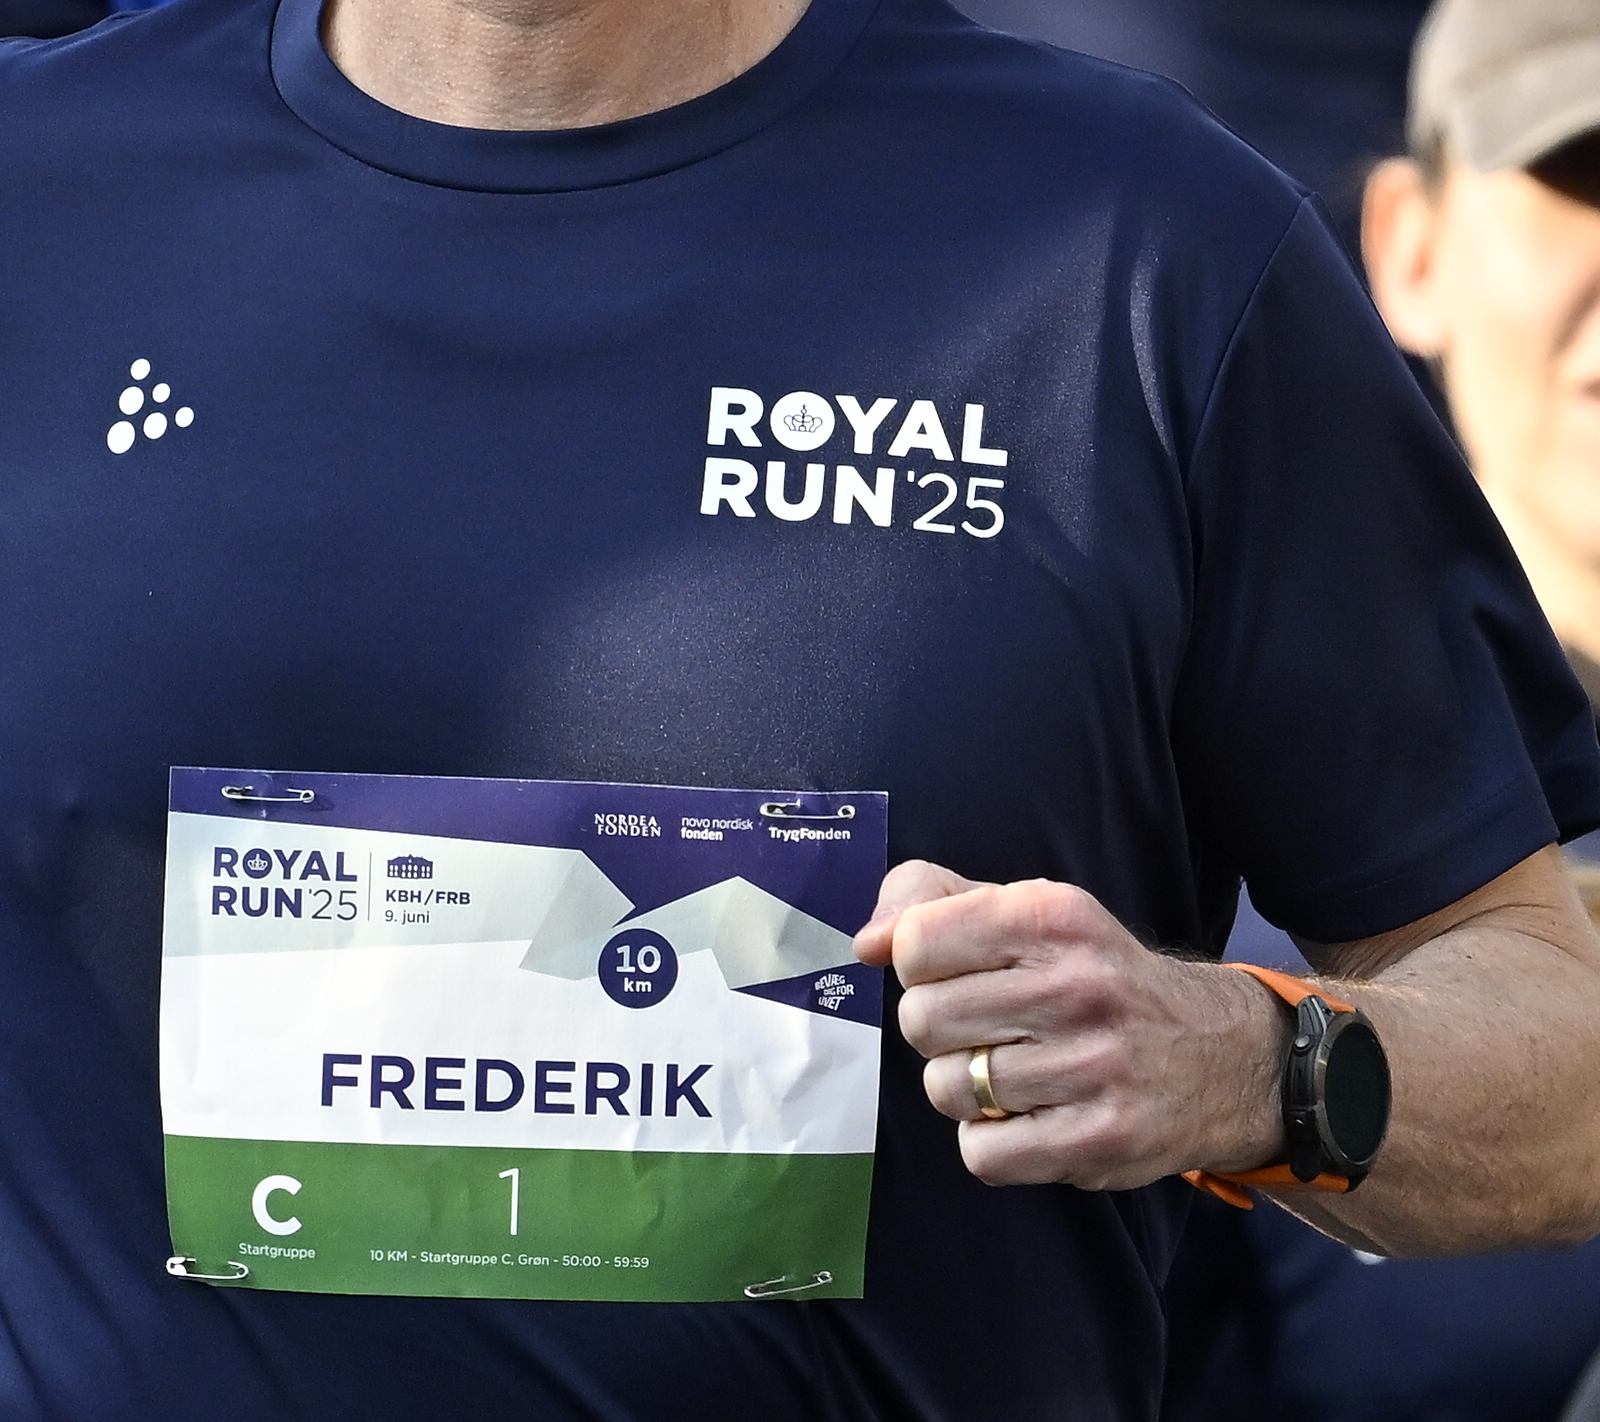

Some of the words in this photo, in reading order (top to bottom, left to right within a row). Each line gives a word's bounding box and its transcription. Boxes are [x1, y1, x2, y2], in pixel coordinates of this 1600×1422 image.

[706, 386, 1008, 467] ROYAL
[594, 813, 657, 828] NORDEA
[681, 817, 710, 829] novo
[712, 817, 754, 831] nordisk
[597, 825, 662, 838] FONDEN
[681, 827, 724, 842] fonden
[768, 827, 851, 843] TrygFonden
[212, 846, 358, 882] ROYAL
[385, 889, 472, 906] KBH/FRB
[384, 910, 398, 923] 9.
[401, 910, 430, 925] juni
[615, 945, 662, 974] 10
[623, 977, 652, 993] km
[836, 984, 855, 996] FOR
[320, 1053, 715, 1119] FREDERIK
[251, 1175, 303, 1236] C
[498, 1168, 520, 1237] 1
[238, 1242, 316, 1261] Startgruppe
[369, 1249, 383, 1262] 10
[387, 1250, 408, 1263] KM
[420, 1251, 498, 1266] Startgruppe
[501, 1253, 515, 1266] C,
[517, 1254, 549, 1266] Grøn
[562, 1255, 601, 1267] 50:00
[613, 1256, 650, 1269] 59:59
